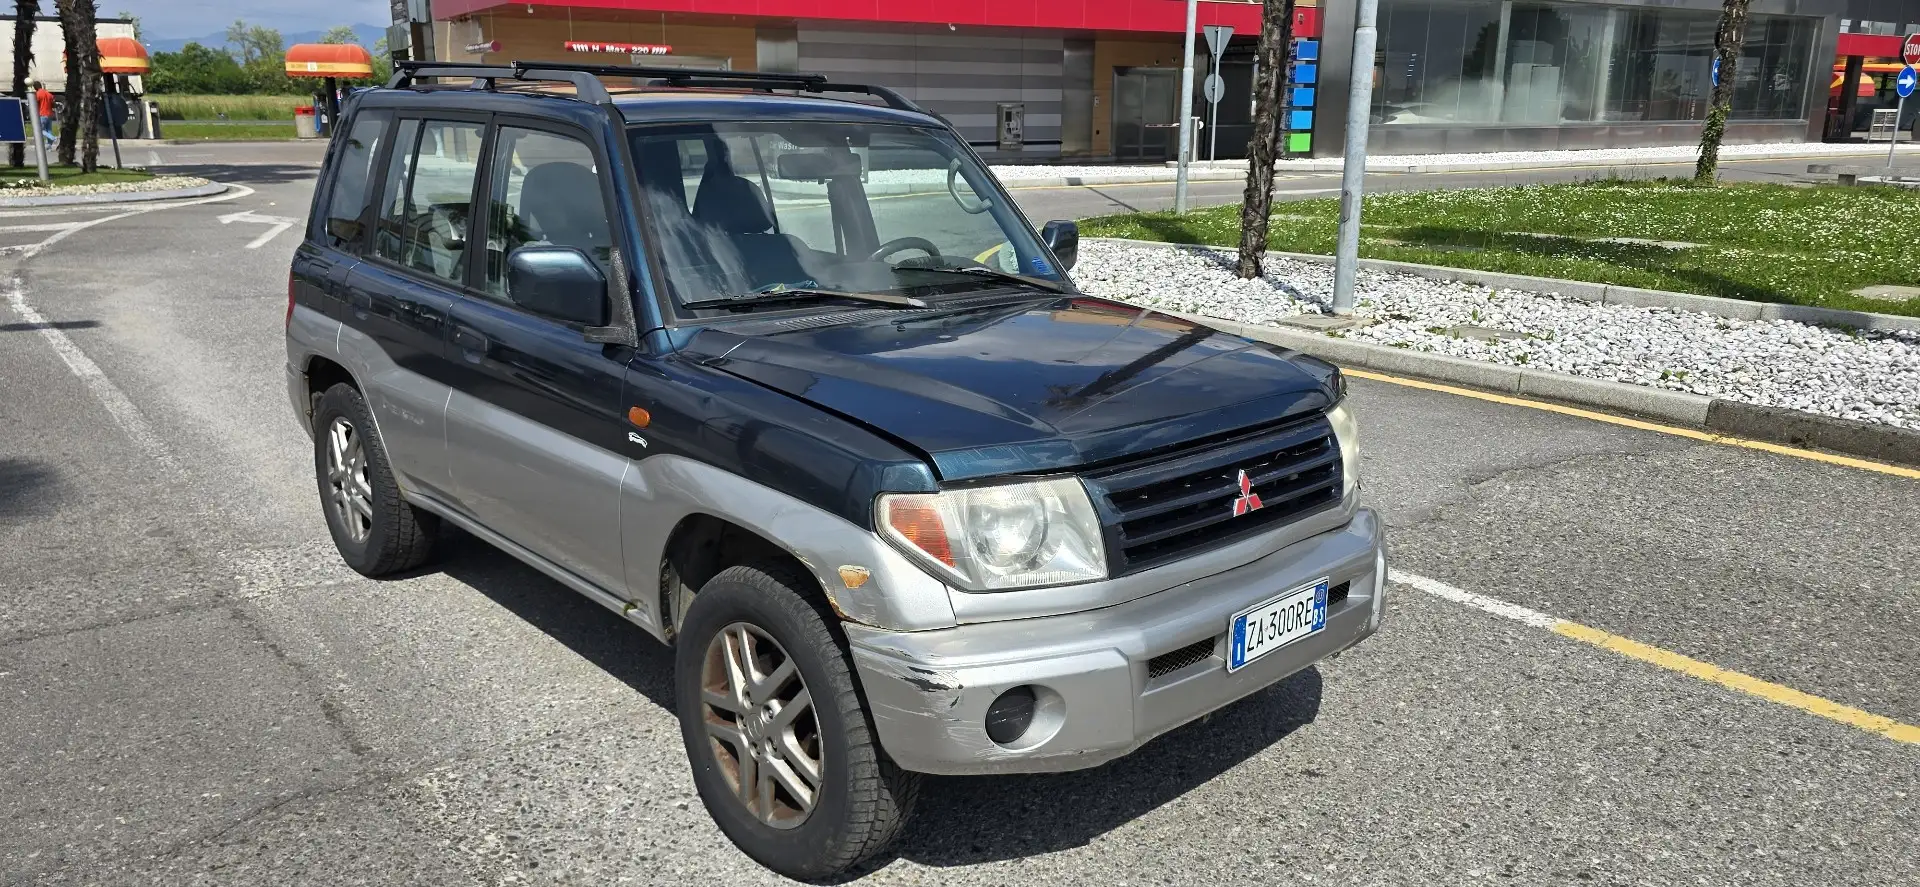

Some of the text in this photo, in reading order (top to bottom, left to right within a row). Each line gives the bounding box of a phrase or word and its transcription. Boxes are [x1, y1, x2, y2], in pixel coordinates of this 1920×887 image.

[592, 44, 649, 54] H. Max. 220
[1313, 606, 1325, 626] BS
[1236, 642, 1241, 661] I
